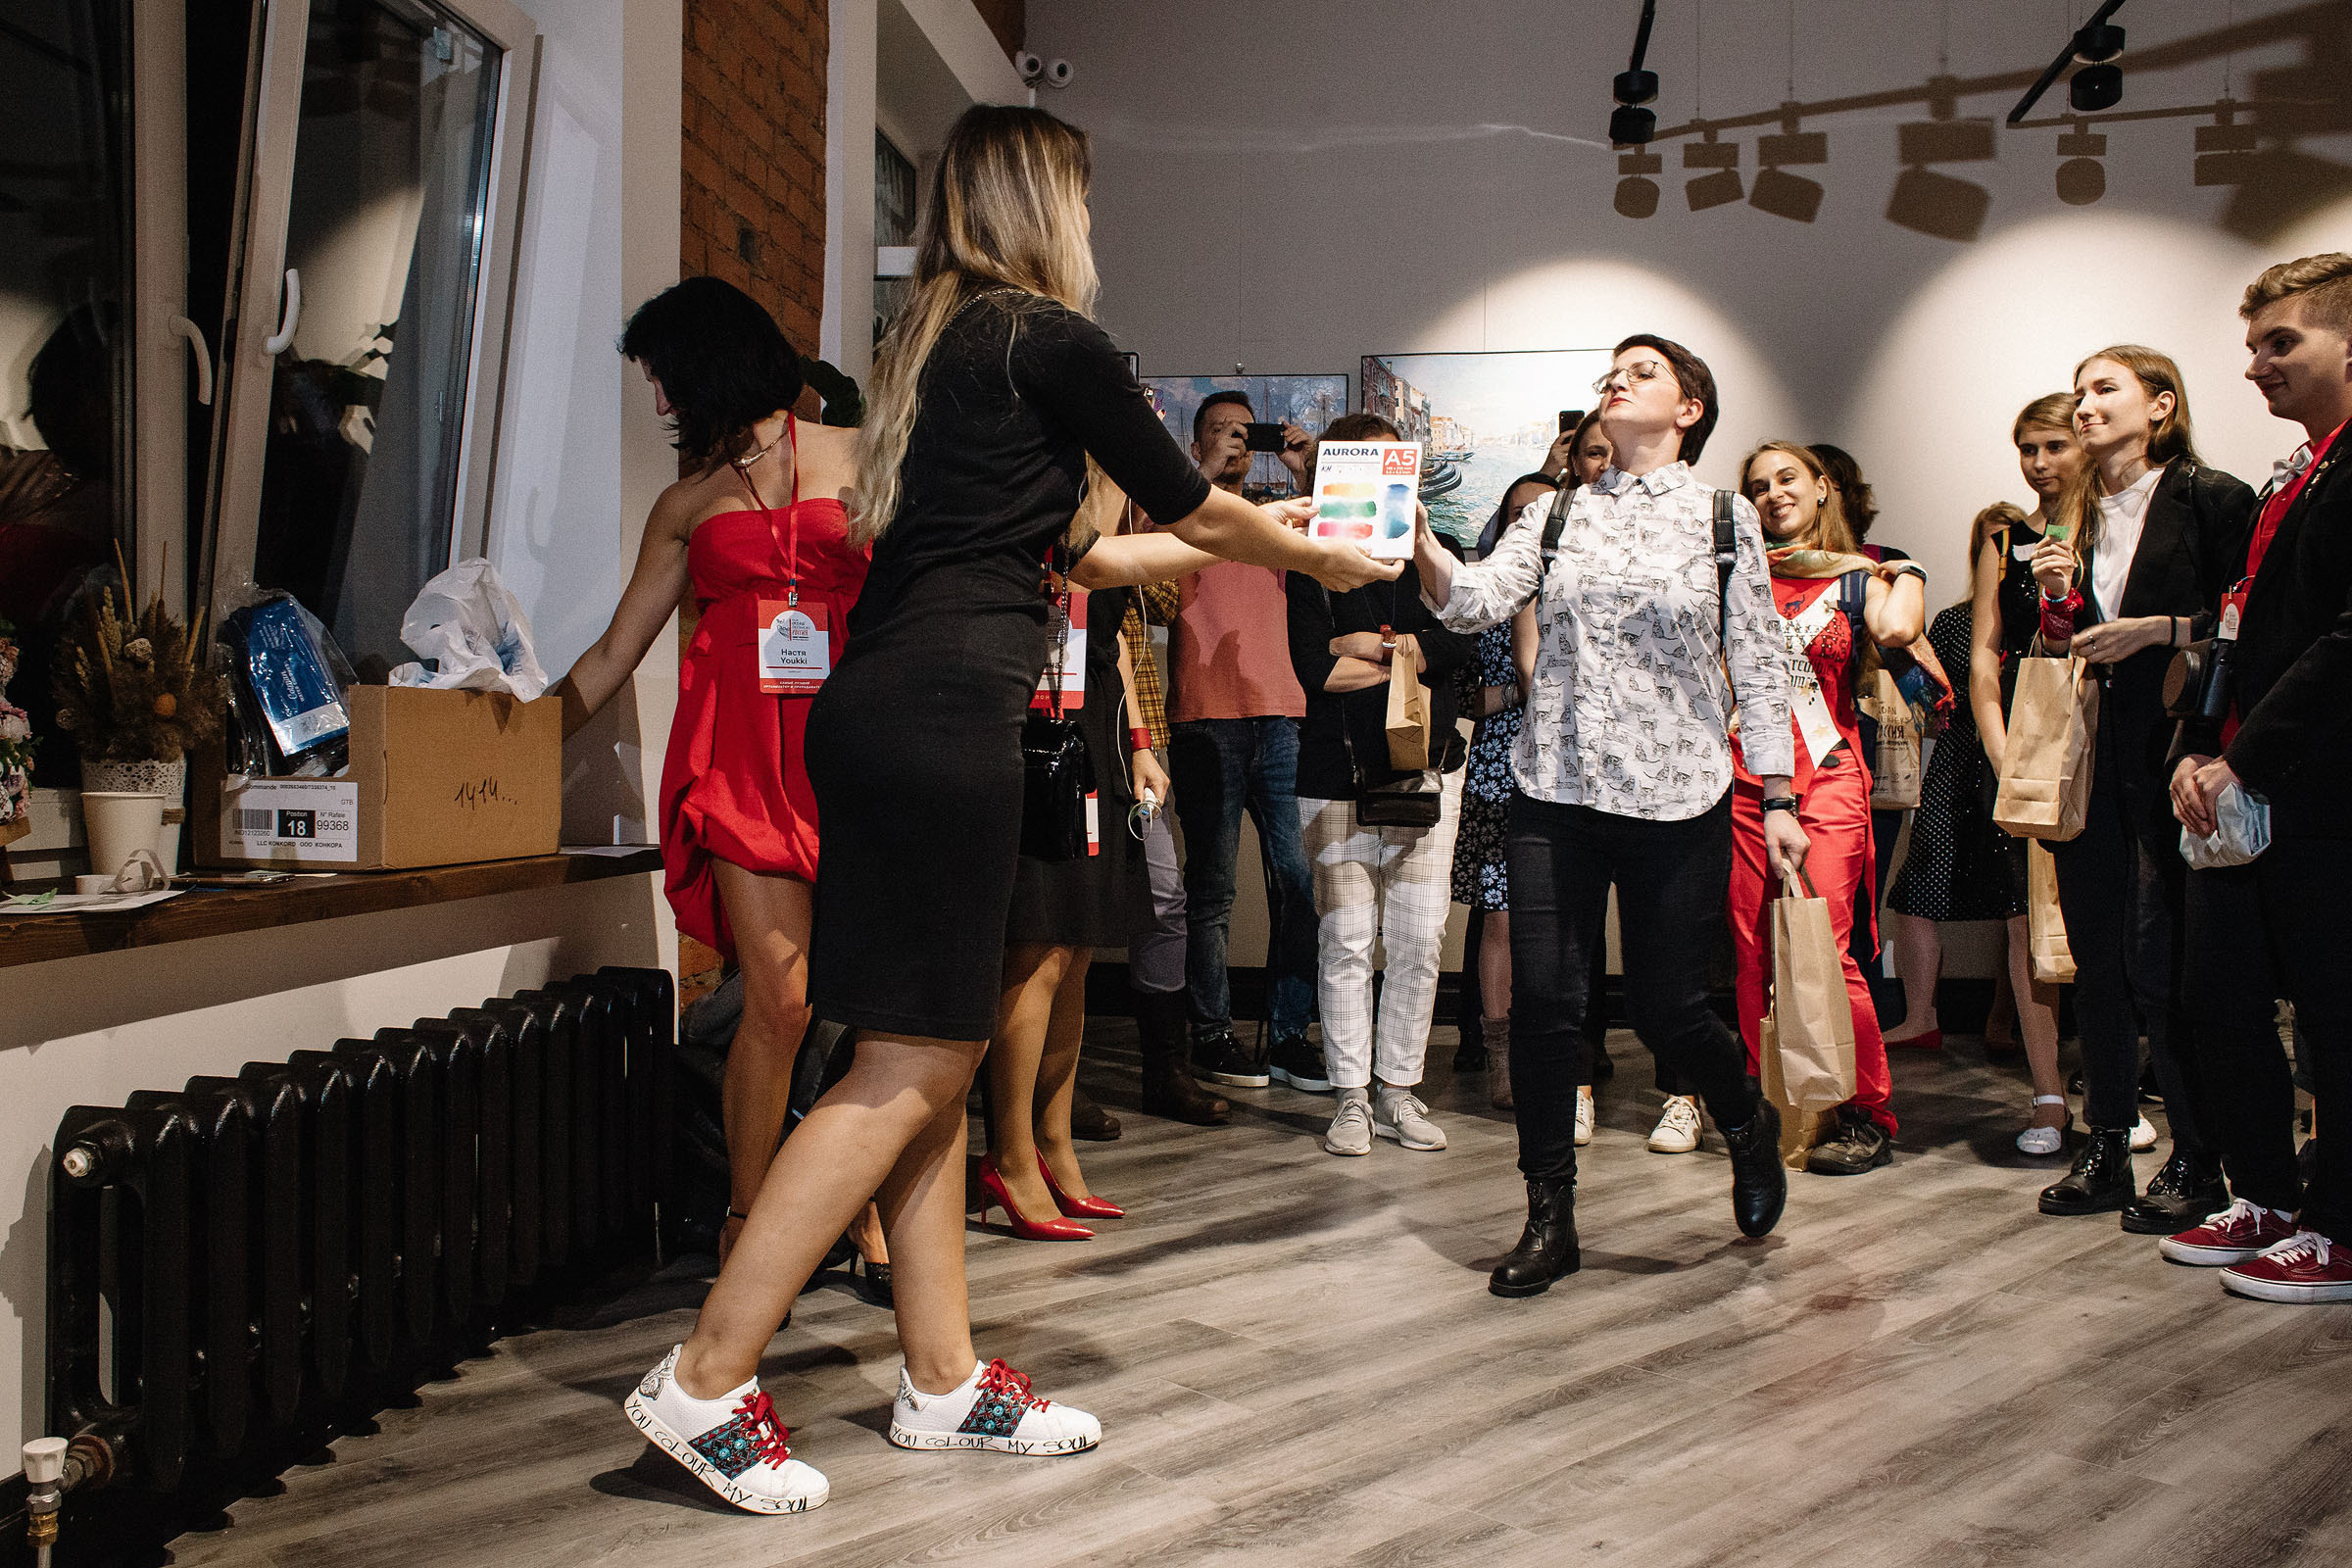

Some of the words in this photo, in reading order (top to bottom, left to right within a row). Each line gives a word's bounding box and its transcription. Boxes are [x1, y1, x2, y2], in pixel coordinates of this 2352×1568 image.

[1384, 450, 1415, 466] A5
[286, 819, 307, 836] 18
[316, 819, 350, 831] 99368
[892, 1425, 918, 1446] YOU
[925, 1435, 1000, 1450] COLOUR
[1007, 1439, 1035, 1455] MY
[1043, 1433, 1097, 1453] SOUL
[625, 1398, 653, 1430] YOU
[654, 1430, 716, 1488] COLOUR
[722, 1481, 754, 1504] MY
